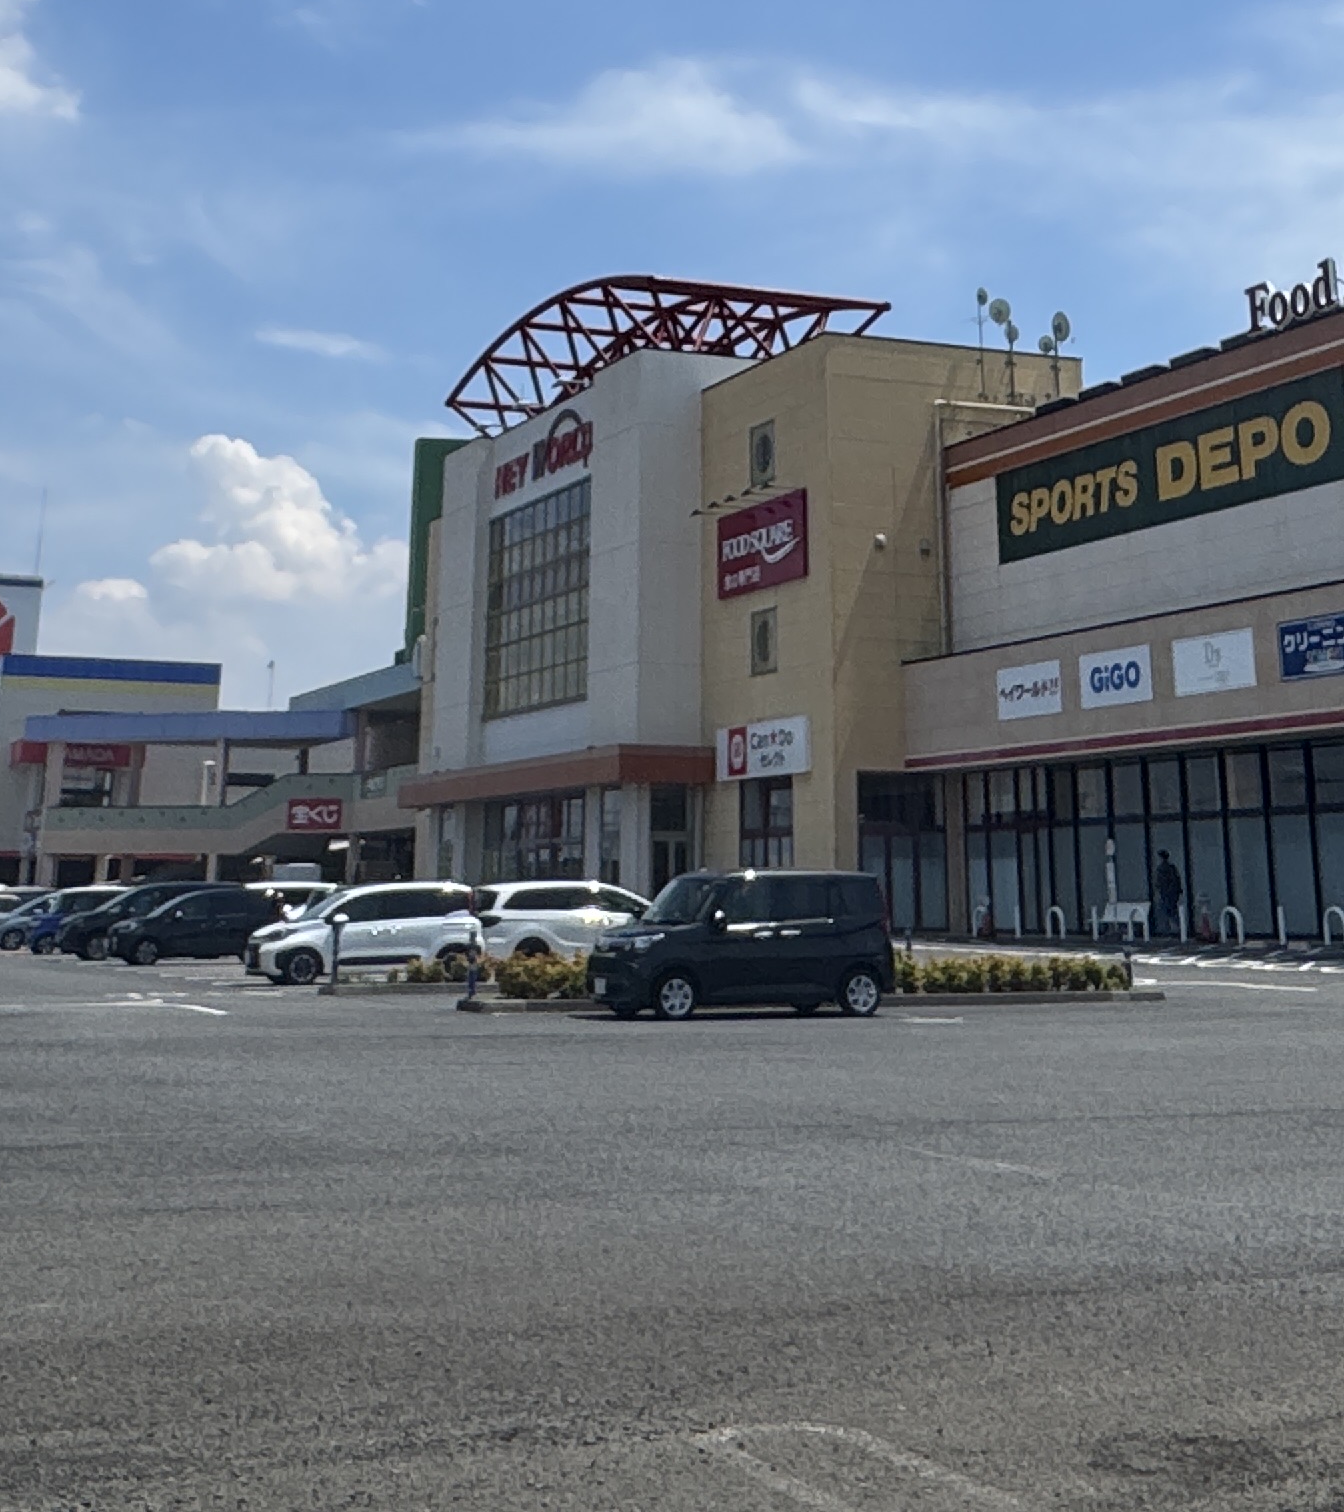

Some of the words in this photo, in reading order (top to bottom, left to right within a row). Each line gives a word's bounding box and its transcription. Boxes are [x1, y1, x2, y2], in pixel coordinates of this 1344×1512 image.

[1244, 257, 1339, 335] Food
[1010, 459, 1138, 536] SPORTS
[1156, 400, 1332, 502] DEPO
[1090, 660, 1141, 694] GiGO
[291, 805, 339, 824] 宝くじ
